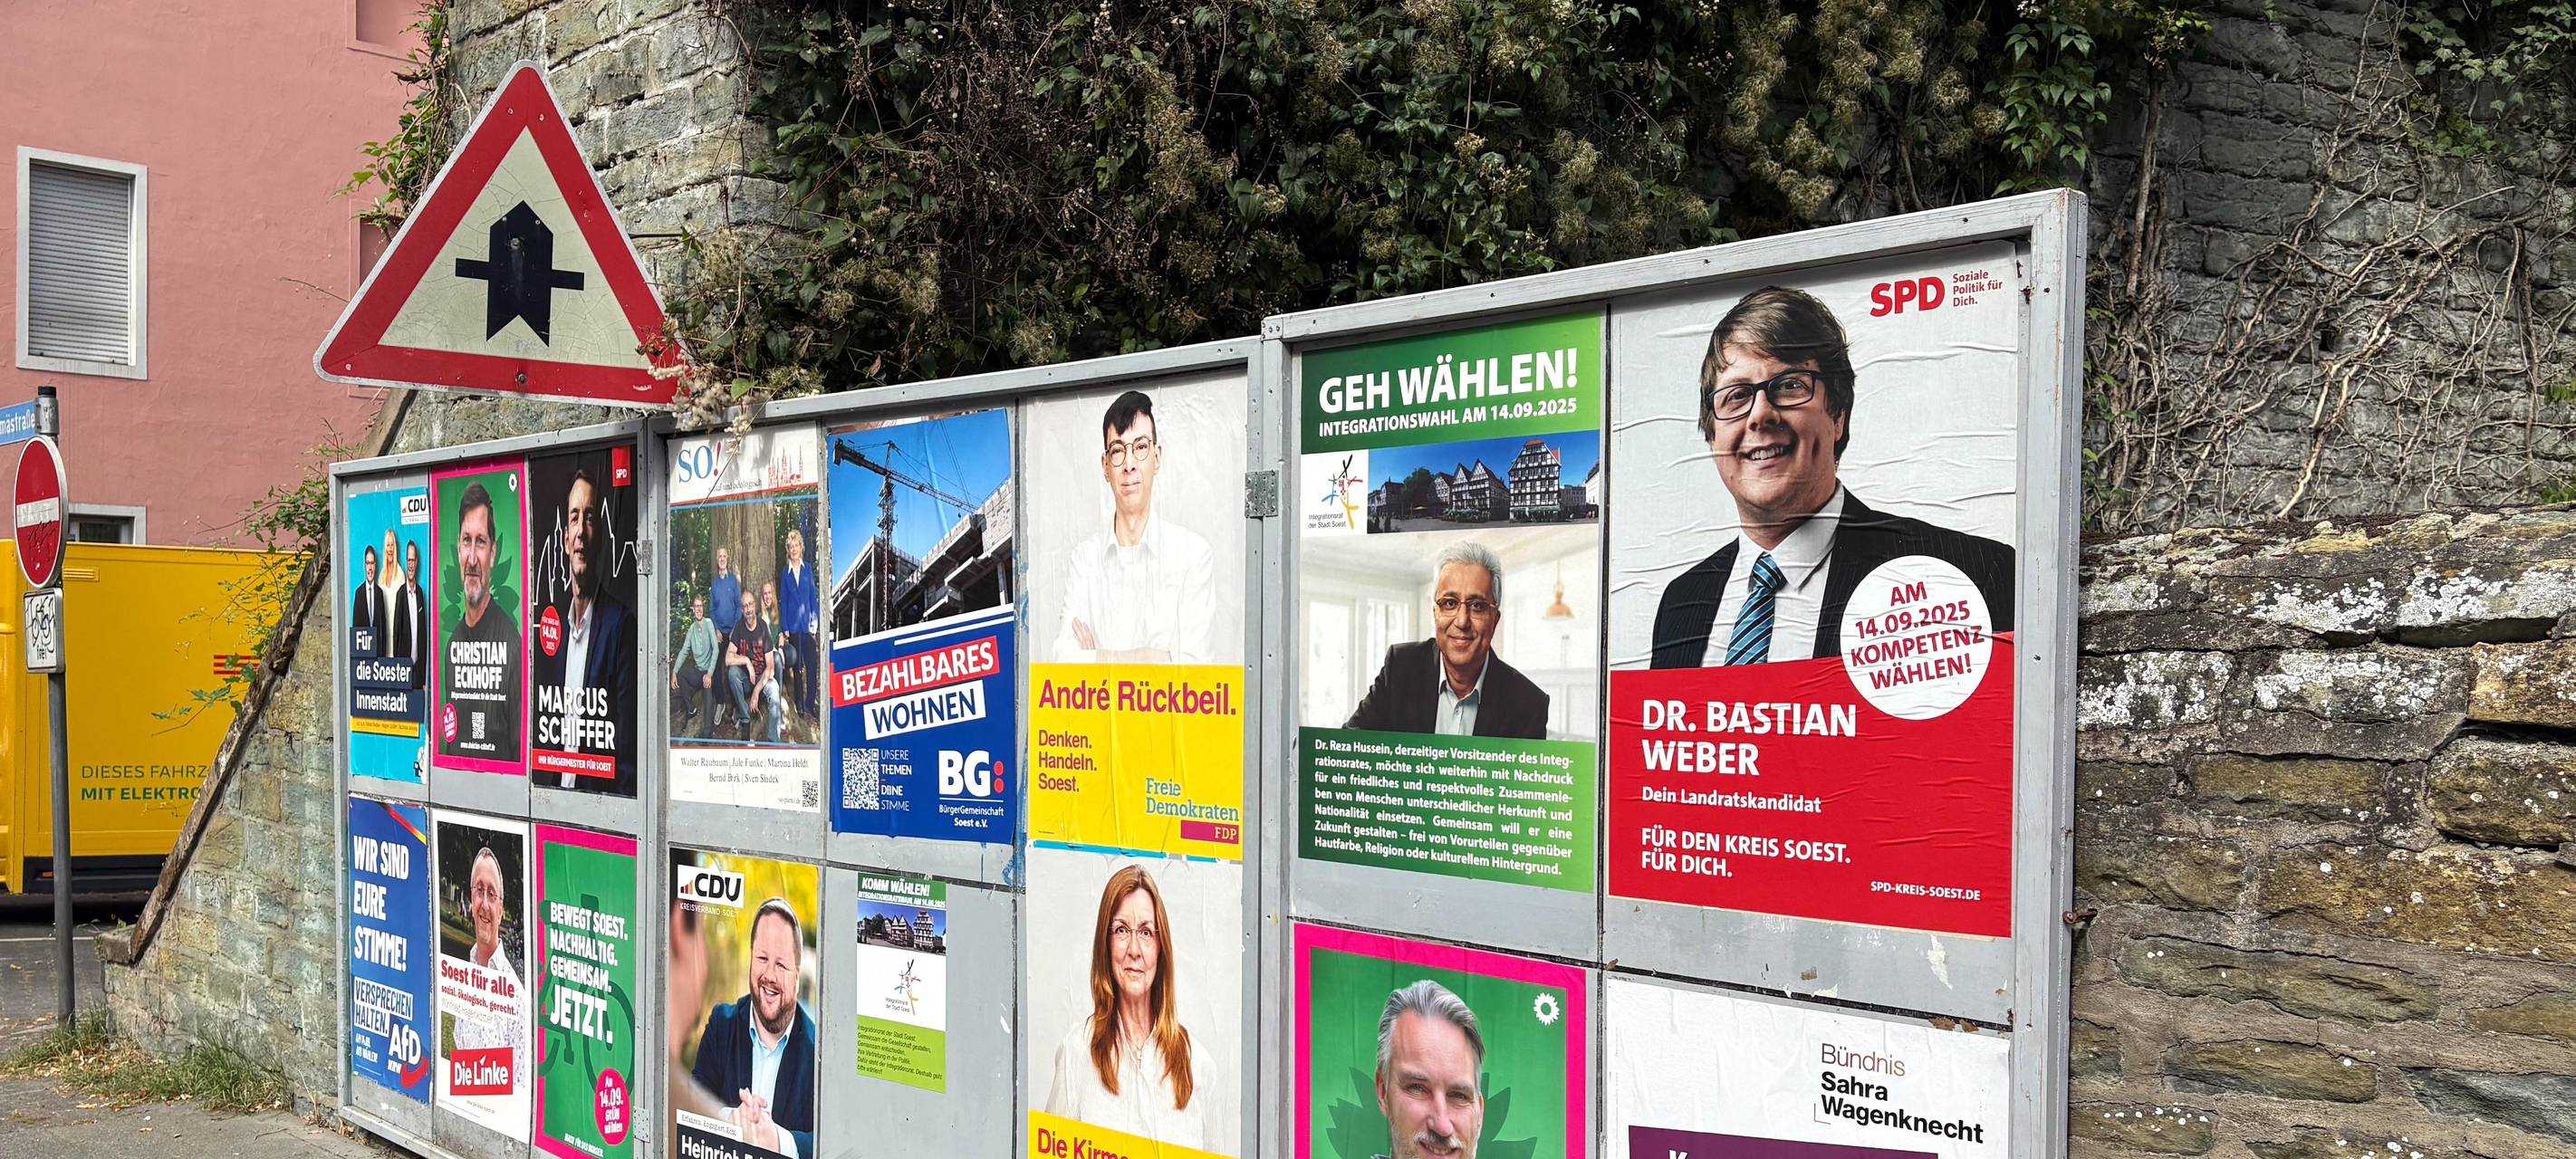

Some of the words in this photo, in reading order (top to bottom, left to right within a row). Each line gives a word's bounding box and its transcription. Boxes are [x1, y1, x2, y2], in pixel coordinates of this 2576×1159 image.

[1953, 270, 1989, 283] Soziale
[1953, 283, 1985, 295] Politik
[1987, 280, 2003, 291] für
[1870, 276, 1946, 318] SPD
[1953, 296, 1978, 307] Dich.
[1319, 371, 1389, 414] GEH
[1399, 348, 1579, 406] WÄHLEN!
[1319, 409, 1459, 437] INTEGRATIONSWAHL
[1462, 407, 1486, 424] AM
[1490, 398, 1578, 420] 14.09.2025
[616, 468, 627, 478] SPD
[678, 441, 722, 483] SO!
[408, 497, 427, 513] CDU
[1889, 581, 1927, 607] AM
[1855, 600, 1971, 639] 14.09.2025
[356, 631, 373, 651] Für
[450, 641, 507, 665] CHRISTIAN
[1850, 626, 1985, 667] KOMPETENZ
[356, 660, 371, 681] die
[373, 661, 411, 683] Soester
[455, 666, 503, 689] ECKHOFF
[841, 642, 994, 701] BEZAHLBARES
[1869, 653, 1972, 690] WÄHLEN!
[356, 690, 408, 713] Innenstadt
[538, 685, 608, 716] MARCUS
[871, 687, 976, 733] WOHNEN
[1039, 679, 1110, 711] André
[1118, 680, 1236, 715] Rückbeil.
[538, 715, 615, 750] SCHIFFER
[1642, 699, 1697, 733] DR.
[1706, 701, 1857, 738] BASTIAN
[1038, 729, 1092, 749] Denken.
[1315, 739, 1328, 750] Dr.
[1331, 741, 1351, 752] Reza
[1353, 742, 1392, 756] Hussein,
[1395, 743, 1448, 760] derzeitiger
[1449, 748, 1516, 762] Vorsitzender
[1519, 752, 1537, 764] des
[1540, 753, 1573, 769] Integ-
[881, 750, 909, 761] UNSERE
[881, 764, 912, 775] THEMEN
[1038, 752, 1098, 771] Handeln.
[1315, 756, 1372, 771] rationsrates,
[1376, 761, 1411, 773] möchte
[1416, 762, 1435, 775] sich
[1439, 765, 1487, 778] weiterhin
[1492, 768, 1510, 780] mit
[1514, 769, 1573, 785] Nachdruck
[1641, 739, 1760, 776] WEBER
[82, 765, 145, 779] DIESES
[150, 765, 210, 779] FAHRZ
[938, 750, 1004, 797] BG:
[1038, 772, 1080, 792] Soest.
[1146, 778, 1182, 797] Freie
[1315, 771, 1329, 783] für
[1332, 773, 1346, 784] ein
[1350, 773, 1399, 789] friedliches
[1403, 780, 1422, 790] und
[1427, 782, 1495, 796] respektvolles
[1499, 786, 1572, 803] Zusammenle-
[81, 788, 116, 800] MIT
[120, 787, 201, 800] ELEKTRO
[881, 800, 910, 811] STIMME
[1146, 797, 1240, 821] Demokraten
[1315, 787, 1332, 799] ben
[1335, 792, 1352, 801] von
[1356, 791, 1404, 806] Menschen
[1407, 798, 1495, 814] unterschiedlicher
[1498, 804, 1547, 819] Herkunft
[1550, 809, 1572, 821] und
[1641, 787, 1677, 803] Dein
[1680, 789, 1822, 814] Landratskandidat
[938, 804, 1004, 816] BürgerGemeinschaft
[954, 818, 974, 828] Soest
[975, 819, 988, 829] e.V.
[1315, 804, 1370, 819] Nationalität
[1376, 810, 1425, 825] einsetzen.
[1433, 815, 1493, 831] Gemeinsam
[1501, 822, 1520, 834] will
[1528, 827, 1540, 836] er
[1548, 827, 1572, 839] eine
[1215, 827, 1237, 840] FDP
[1314, 820, 1351, 834] Zukunft
[1353, 826, 1398, 839] gestalten
[1408, 829, 1426, 842] frei
[1428, 835, 1447, 844] von
[1449, 834, 1508, 850] Vorurteilen
[1512, 842, 1572, 858] gegenüber
[1641, 825, 1677, 848] FÜR
[1681, 831, 1720, 852] DEN
[1725, 835, 1780, 857] KREIS
[1784, 839, 1852, 864] SOEST.
[354, 836, 378, 872] WIR
[380, 843, 409, 880] SIND
[1314, 836, 1363, 853] Hautfarbe,
[1365, 842, 1404, 857] Religion
[1406, 848, 1429, 859] oder
[1431, 849, 1489, 867] kulturellem
[1492, 857, 1562, 876] Hintergrund.
[1641, 849, 1677, 872] FÜR
[1681, 856, 1733, 877] DICH.
[354, 883, 387, 921] EURE
[695, 873, 742, 902] CDU
[861, 877, 889, 891] KOMM
[890, 878, 930, 896] WÄHLEN!
[1870, 880, 1981, 902] SPD-KREIS-SOEST.DE
[550, 901, 591, 931] BEWEGT
[592, 909, 628, 941] SOEST.
[354, 925, 407, 972] STIMME!
[550, 932, 618, 966] NACHHALTIG.
[441, 960, 469, 985] Soest
[471, 968, 488, 991] für
[491, 976, 515, 999] alle
[550, 959, 611, 992] GEMEINSAM.
[355, 980, 412, 1018] VERSPRECHEN
[457, 989, 488, 1008] ökologisch.
[489, 1001, 516, 1016] gerecht.
[550, 985, 613, 1043] JETZT.
[356, 1004, 388, 1034] HALTEN.
[389, 1024, 421, 1065] AfD
[454, 1060, 473, 1086] Die
[473, 1055, 509, 1086] Linke
[1821, 1043, 1907, 1078] Bündnis
[600, 1087, 623, 1107] 14.09.
[1821, 1070, 1889, 1102] Sahra
[1821, 1094, 1985, 1144] Wagenknecht
[1038, 1127, 1068, 1158] Die
[1074, 1137, 1129, 1159] Kirm
